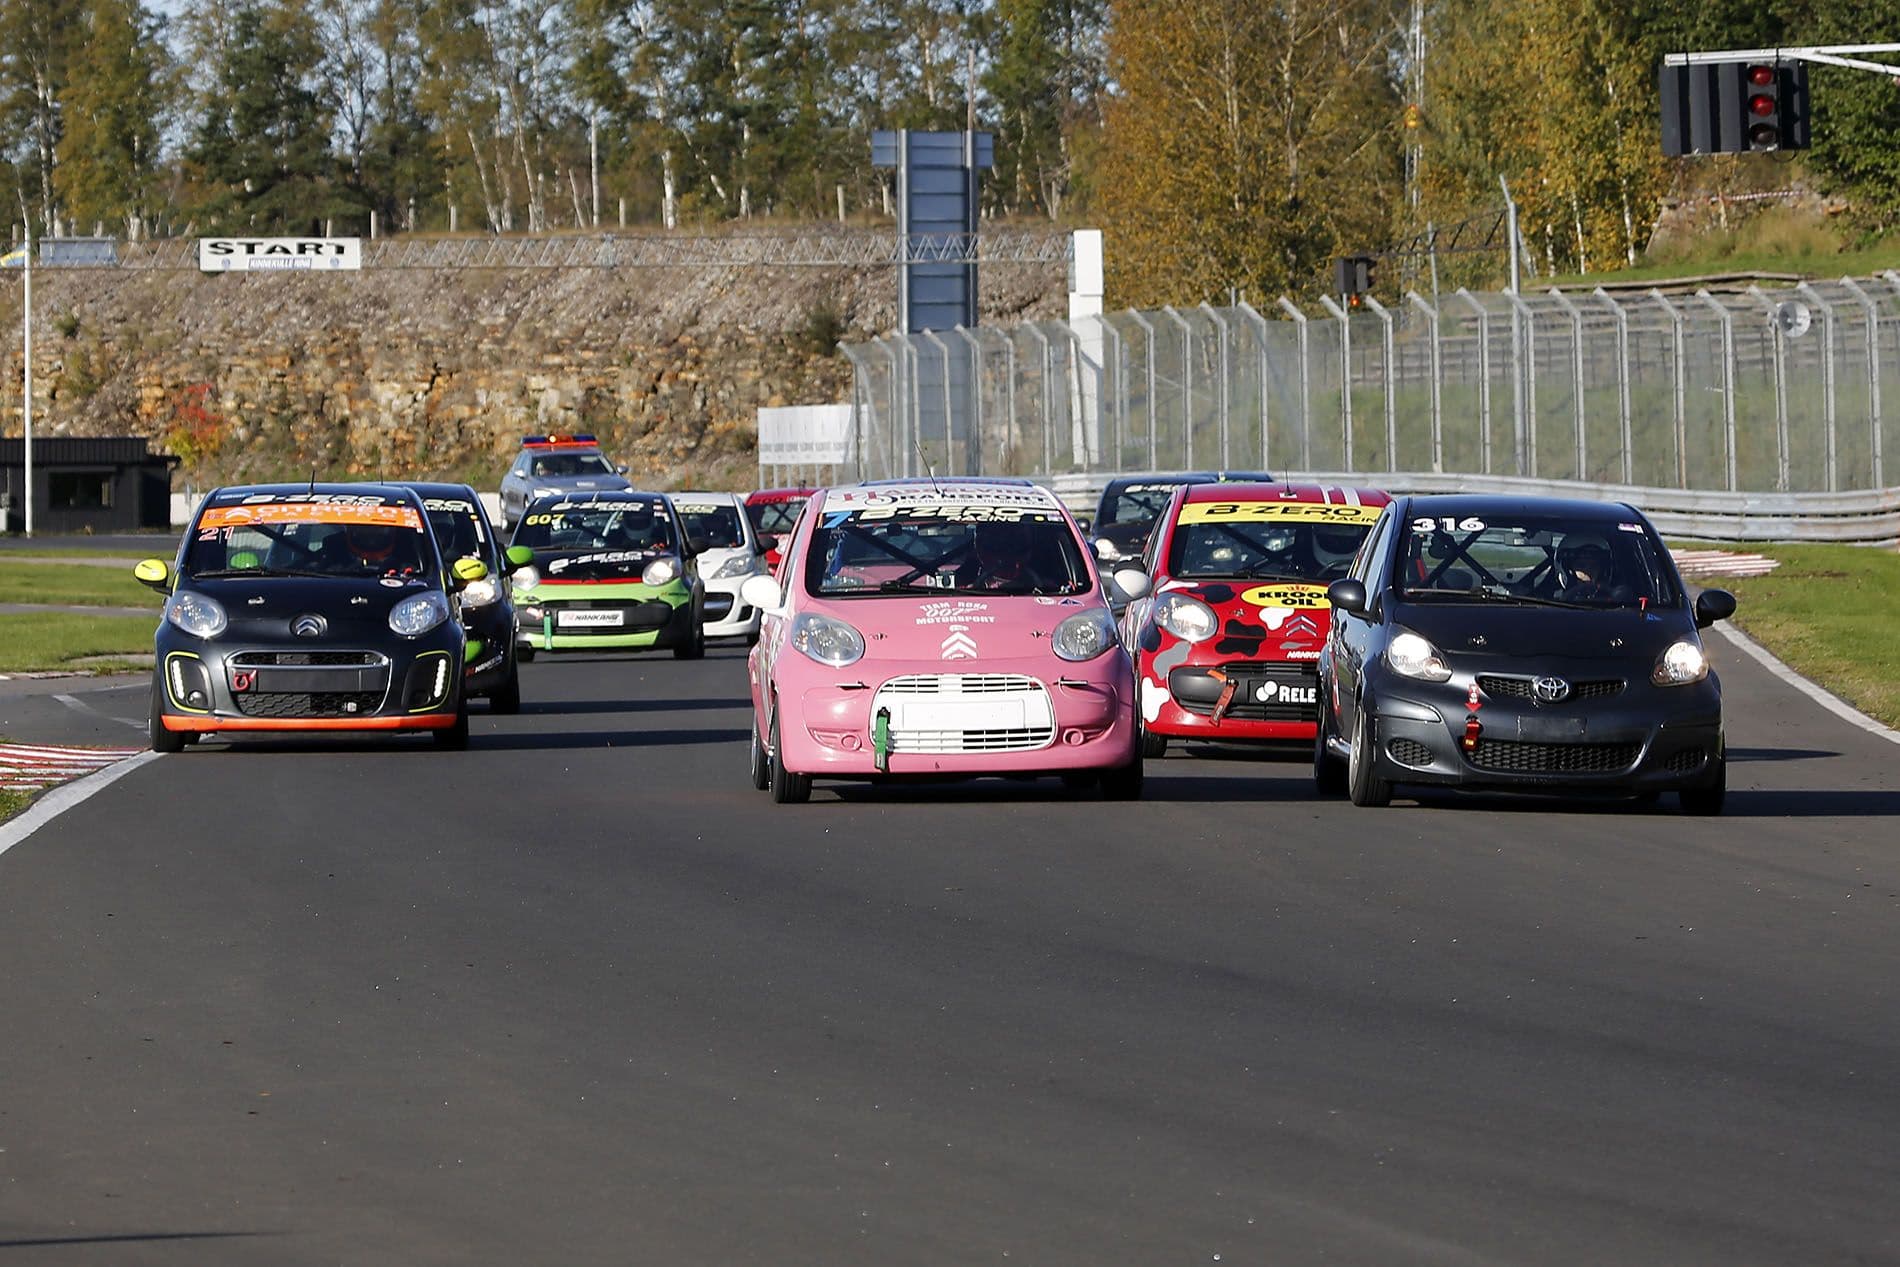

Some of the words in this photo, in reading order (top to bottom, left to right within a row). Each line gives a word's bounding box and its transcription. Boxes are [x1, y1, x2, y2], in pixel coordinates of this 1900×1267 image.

[207, 241, 345, 255] START
[860, 506, 1025, 520] B-ZERO
[1204, 505, 1363, 518] B-ZERO
[526, 514, 565, 525] 607
[1412, 517, 1488, 532] 316
[198, 526, 235, 542] 21
[919, 602, 951, 612] TEAM
[915, 615, 997, 625] MOTORSPORT
[1278, 685, 1317, 704] RELE
